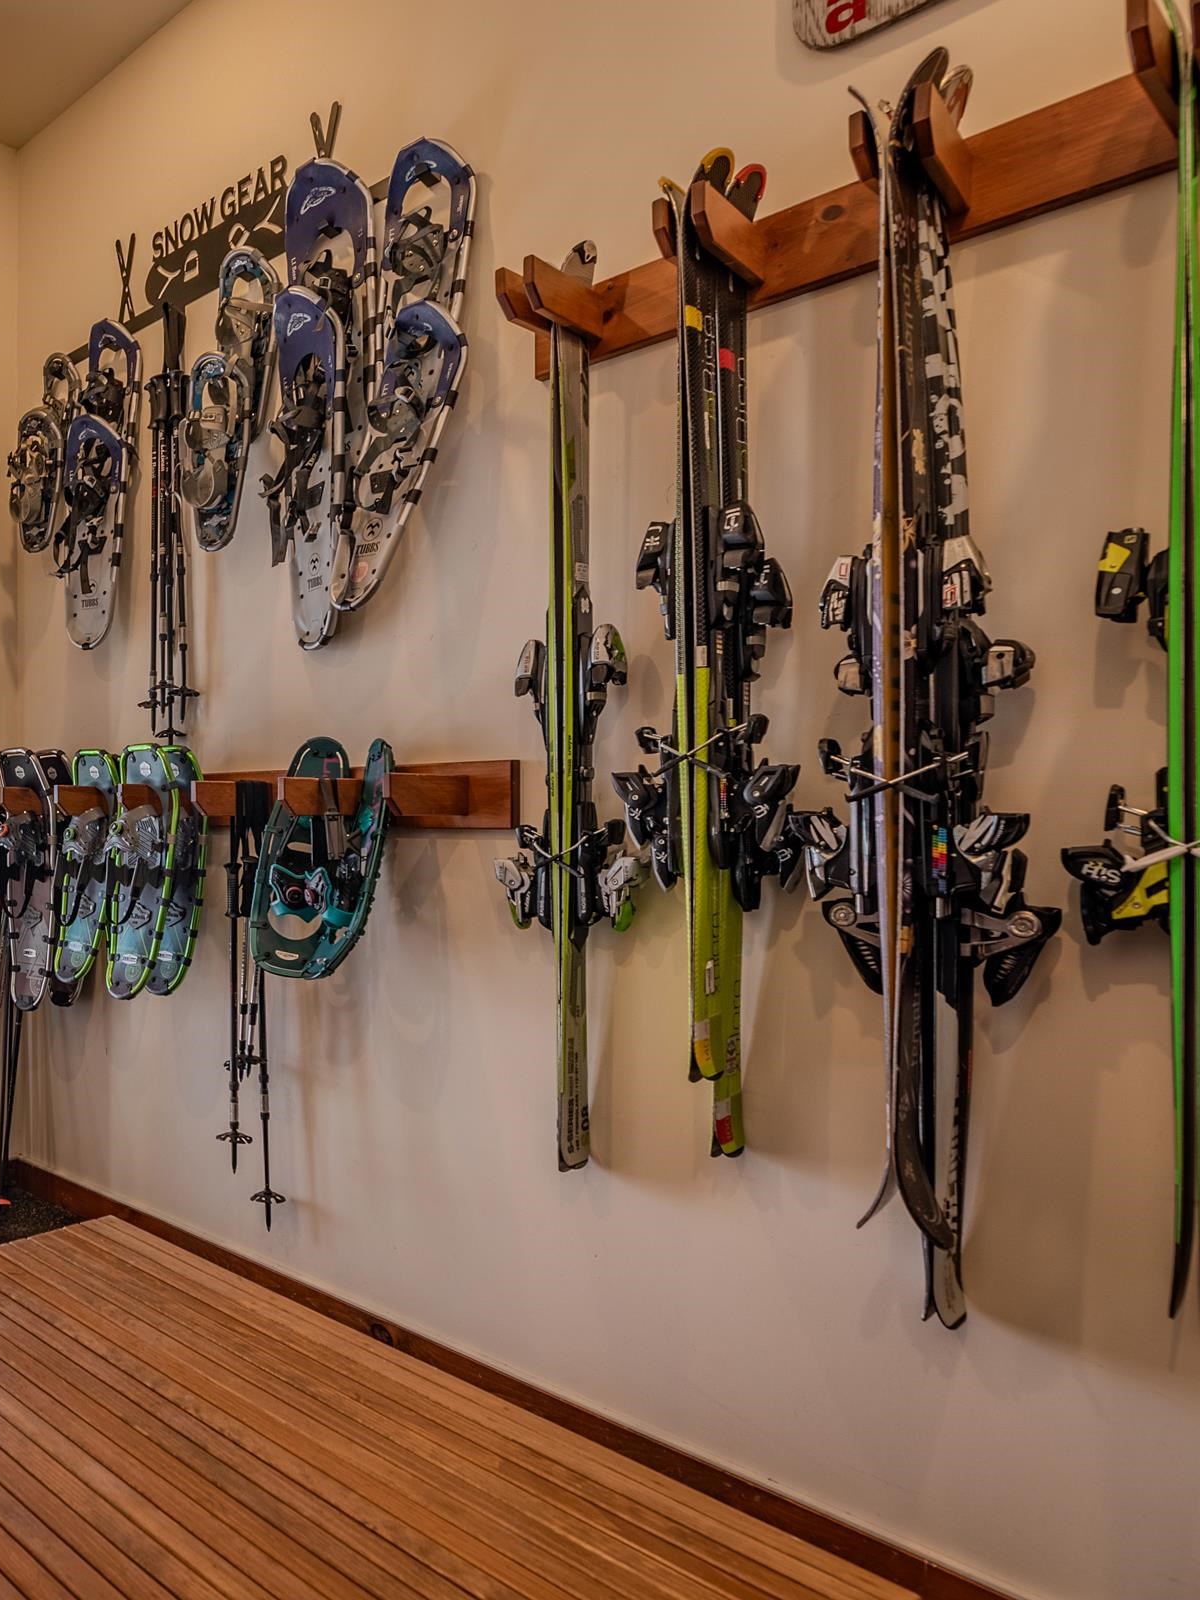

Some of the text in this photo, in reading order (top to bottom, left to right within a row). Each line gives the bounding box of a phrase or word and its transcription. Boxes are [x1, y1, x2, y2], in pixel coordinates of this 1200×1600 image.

[152, 155, 288, 259] SNOW GEAR
[356, 541, 381, 556] TUBBS
